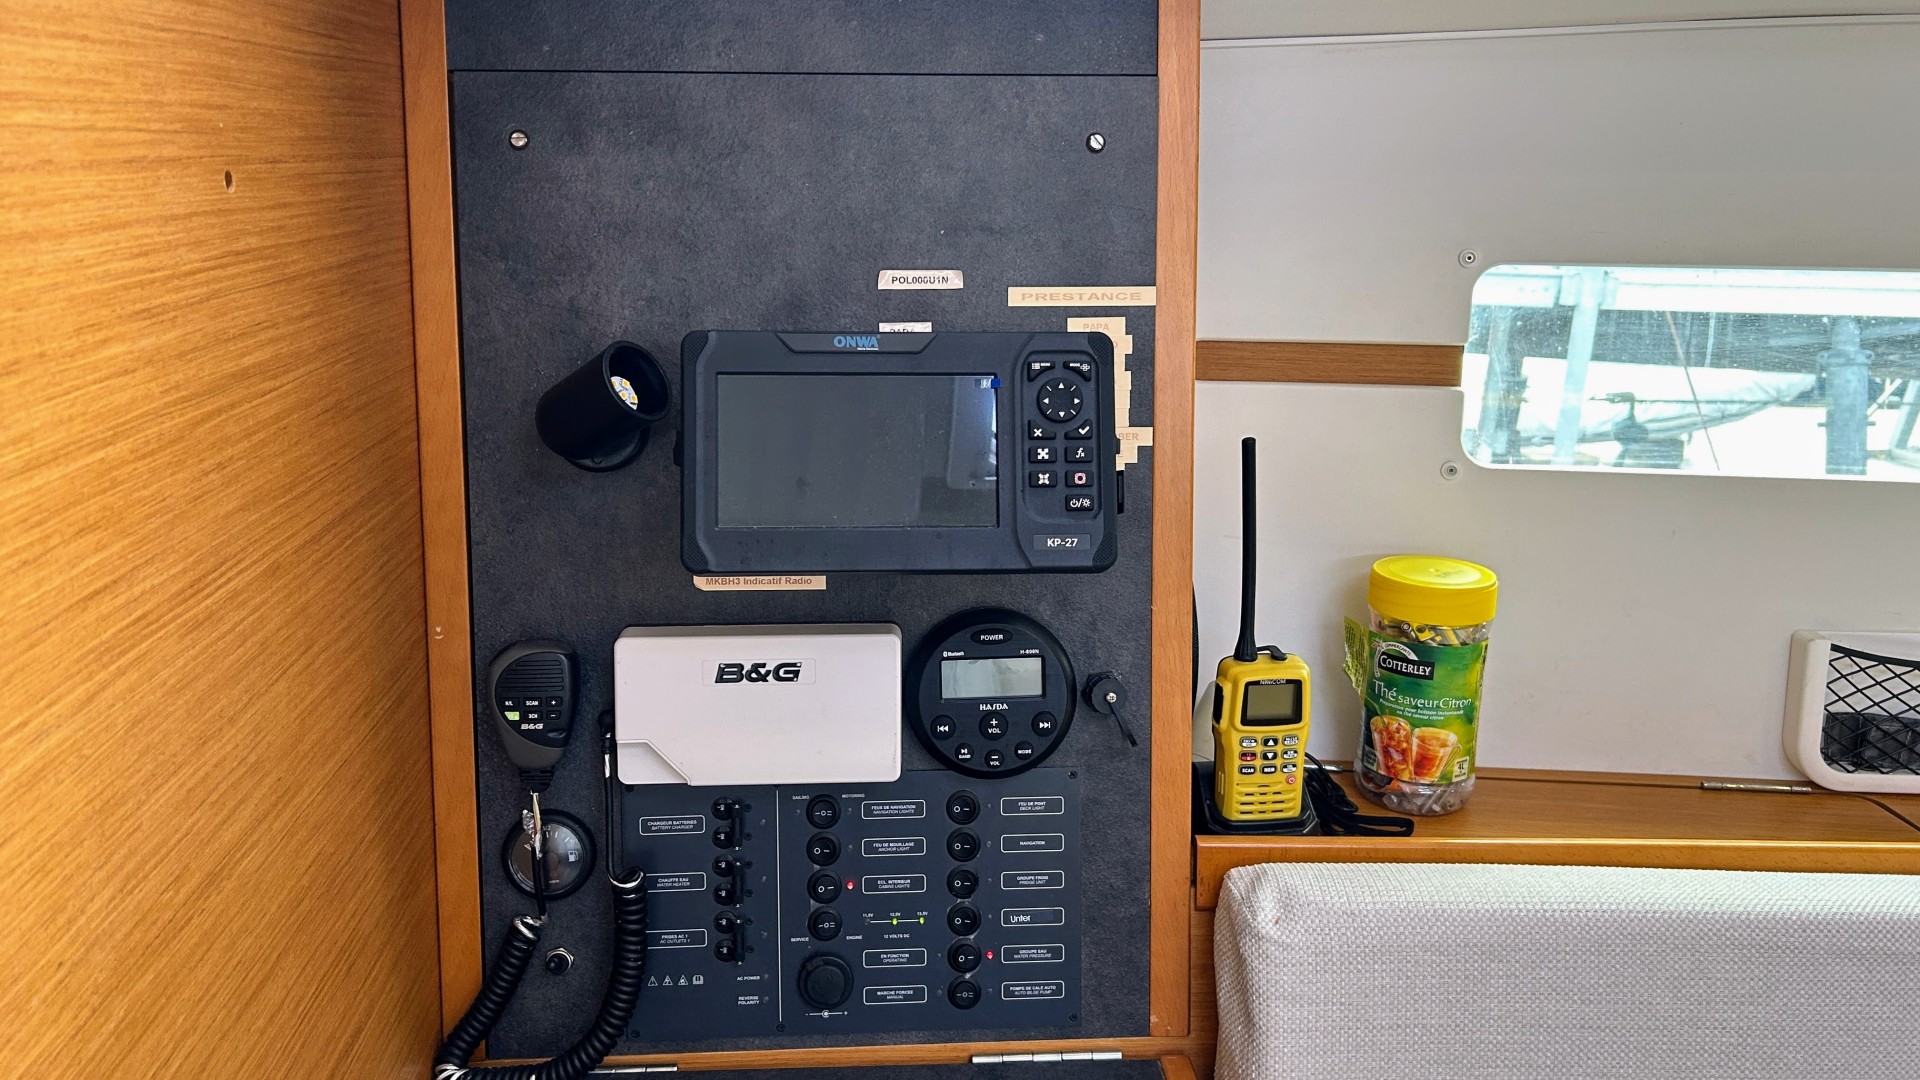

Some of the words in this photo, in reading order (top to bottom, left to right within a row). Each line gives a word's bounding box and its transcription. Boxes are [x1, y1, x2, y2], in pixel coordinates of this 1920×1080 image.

[1021, 292, 1142, 301] PRESTANCE
[1083, 323, 1109, 331] PAPA
[834, 336, 878, 347] ONWA
[1048, 538, 1078, 547] KP-27
[715, 662, 802, 683] B&G
[1373, 679, 1396, 701] Thé
[1398, 695, 1439, 707] saveur
[1440, 698, 1471, 708] Citron
[1010, 915, 1031, 923] Unter
